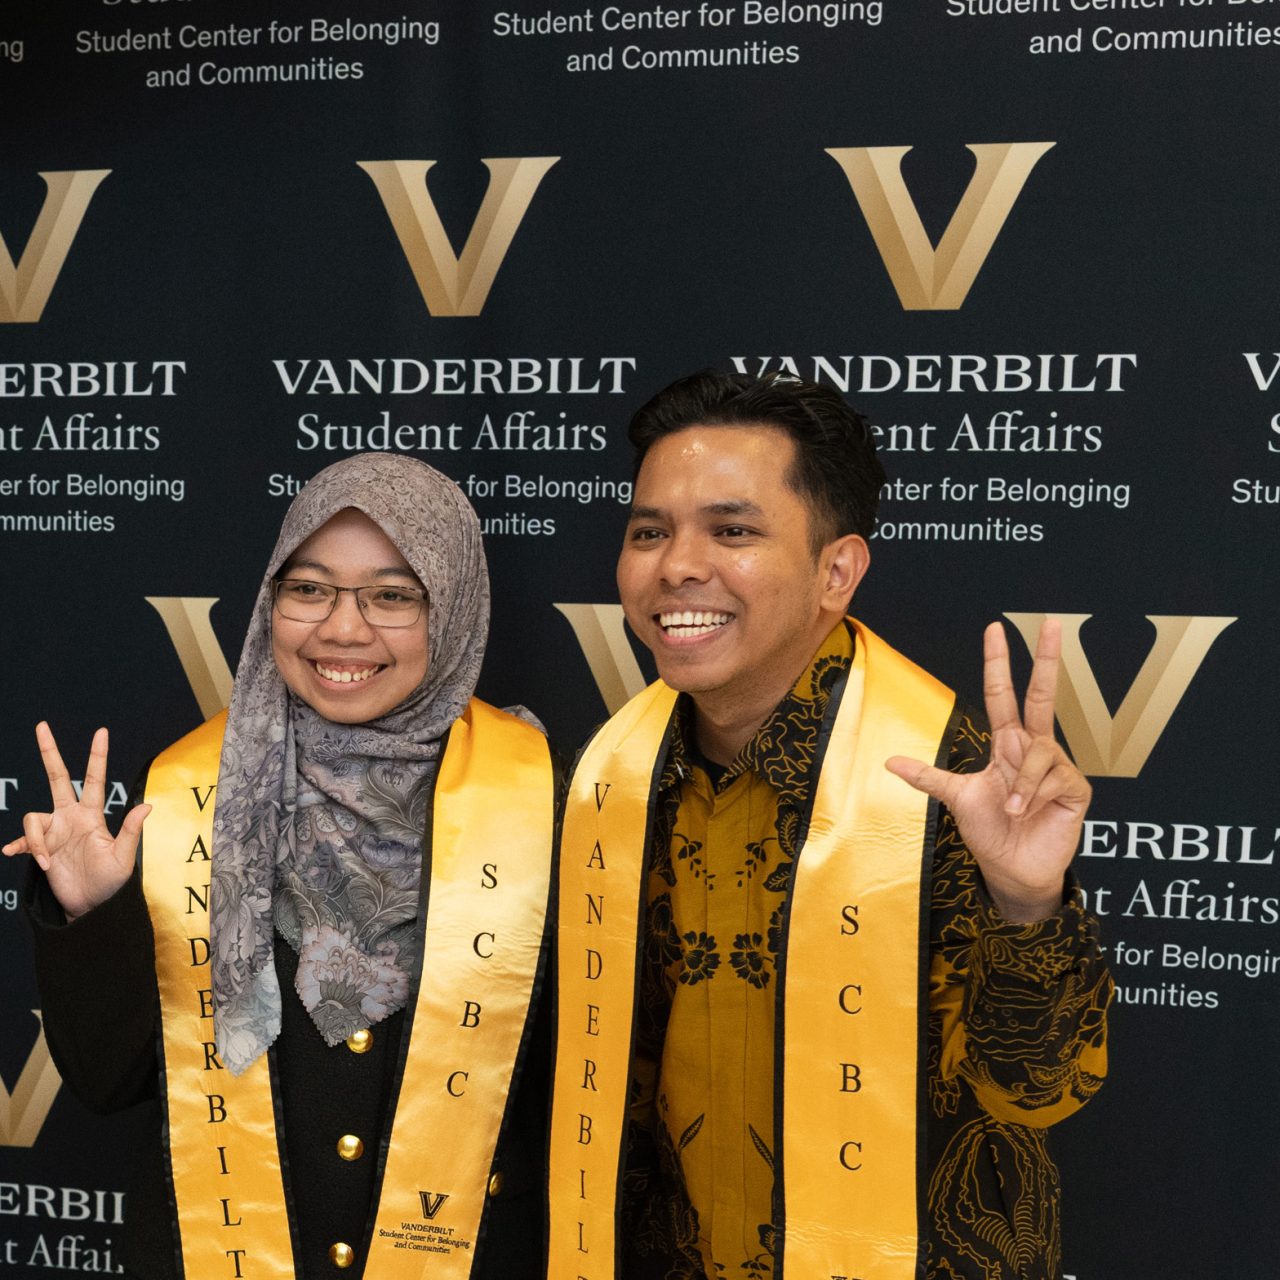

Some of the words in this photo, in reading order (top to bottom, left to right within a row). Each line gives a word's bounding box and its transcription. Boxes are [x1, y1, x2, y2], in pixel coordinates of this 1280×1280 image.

[493, 8, 594, 36] Student
[601, 7, 691, 31] Center
[698, 3, 736, 27] for
[743, 0, 884, 26] Belonging
[75, 28, 172, 53] Student
[178, 24, 263, 48] Center
[268, 21, 303, 44] for
[310, 16, 440, 45] Belonging
[1028, 28, 1082, 54] and
[566, 47, 614, 72] and
[621, 41, 800, 70] Communities
[146, 63, 191, 88] and
[198, 57, 365, 85] Communities
[356, 156, 561, 317] V
[824, 141, 1057, 311] V
[272, 357, 637, 394] VANDERBILT
[32, 413, 160, 451] Affairs
[296, 411, 462, 450] Student
[472, 411, 607, 450] Affairs
[947, 410, 1102, 452] Affairs
[28, 473, 60, 496] for
[66, 473, 185, 501] Belonging
[466, 475, 498, 498] for
[505, 475, 633, 504] Belonging
[879, 480, 932, 501] nter
[939, 478, 978, 501] for
[987, 478, 1130, 508] Belonging
[480, 513, 556, 535] unities
[1002, 612, 1238, 778] V
[1079, 820, 1280, 865] ERBIL
[1121, 879, 1280, 924] Affairs
[1114, 942, 1154, 966] for
[1114, 983, 1219, 1008] unities
[419, 1191, 450, 1220] V
[379, 1229, 404, 1239] Student
[405, 1233, 426, 1242] Center
[426, 1235, 437, 1243] for
[437, 1236, 471, 1249] Belonging
[401, 1222, 455, 1236] VANDERBILT
[27, 1234, 125, 1274] Affai
[394, 1241, 407, 1249] and
[408, 1243, 451, 1254] Communities
